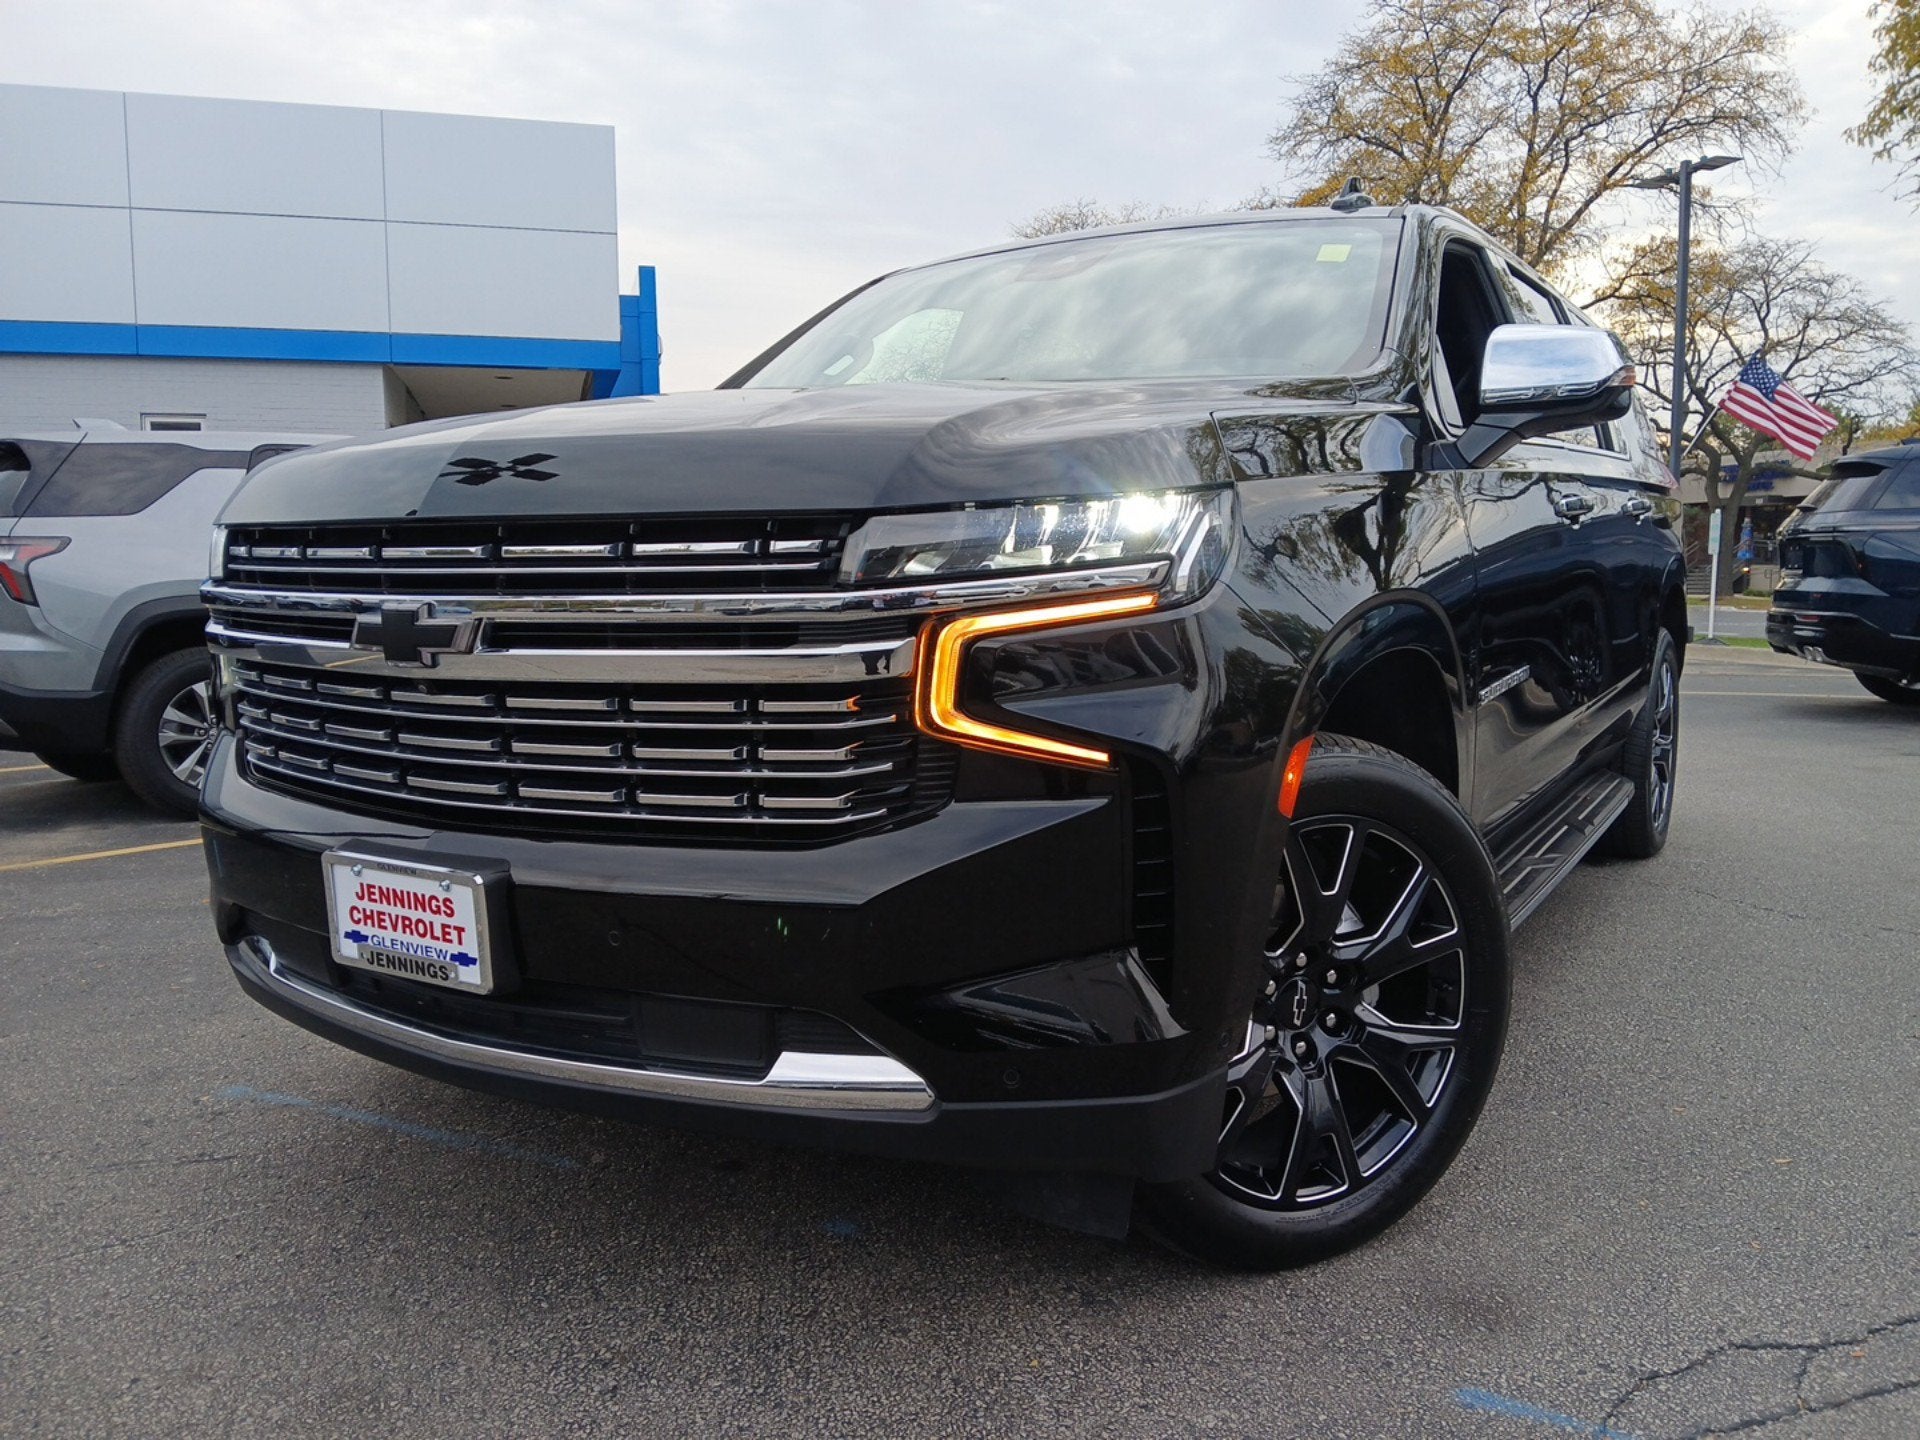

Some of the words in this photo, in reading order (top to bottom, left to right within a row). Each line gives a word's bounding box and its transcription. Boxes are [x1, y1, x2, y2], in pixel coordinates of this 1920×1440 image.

[355, 882, 455, 918] JENNINGS
[349, 906, 466, 946] CHEVROLET
[370, 934, 449, 961] GLENVIEW
[367, 950, 450, 981] JENNINGS
